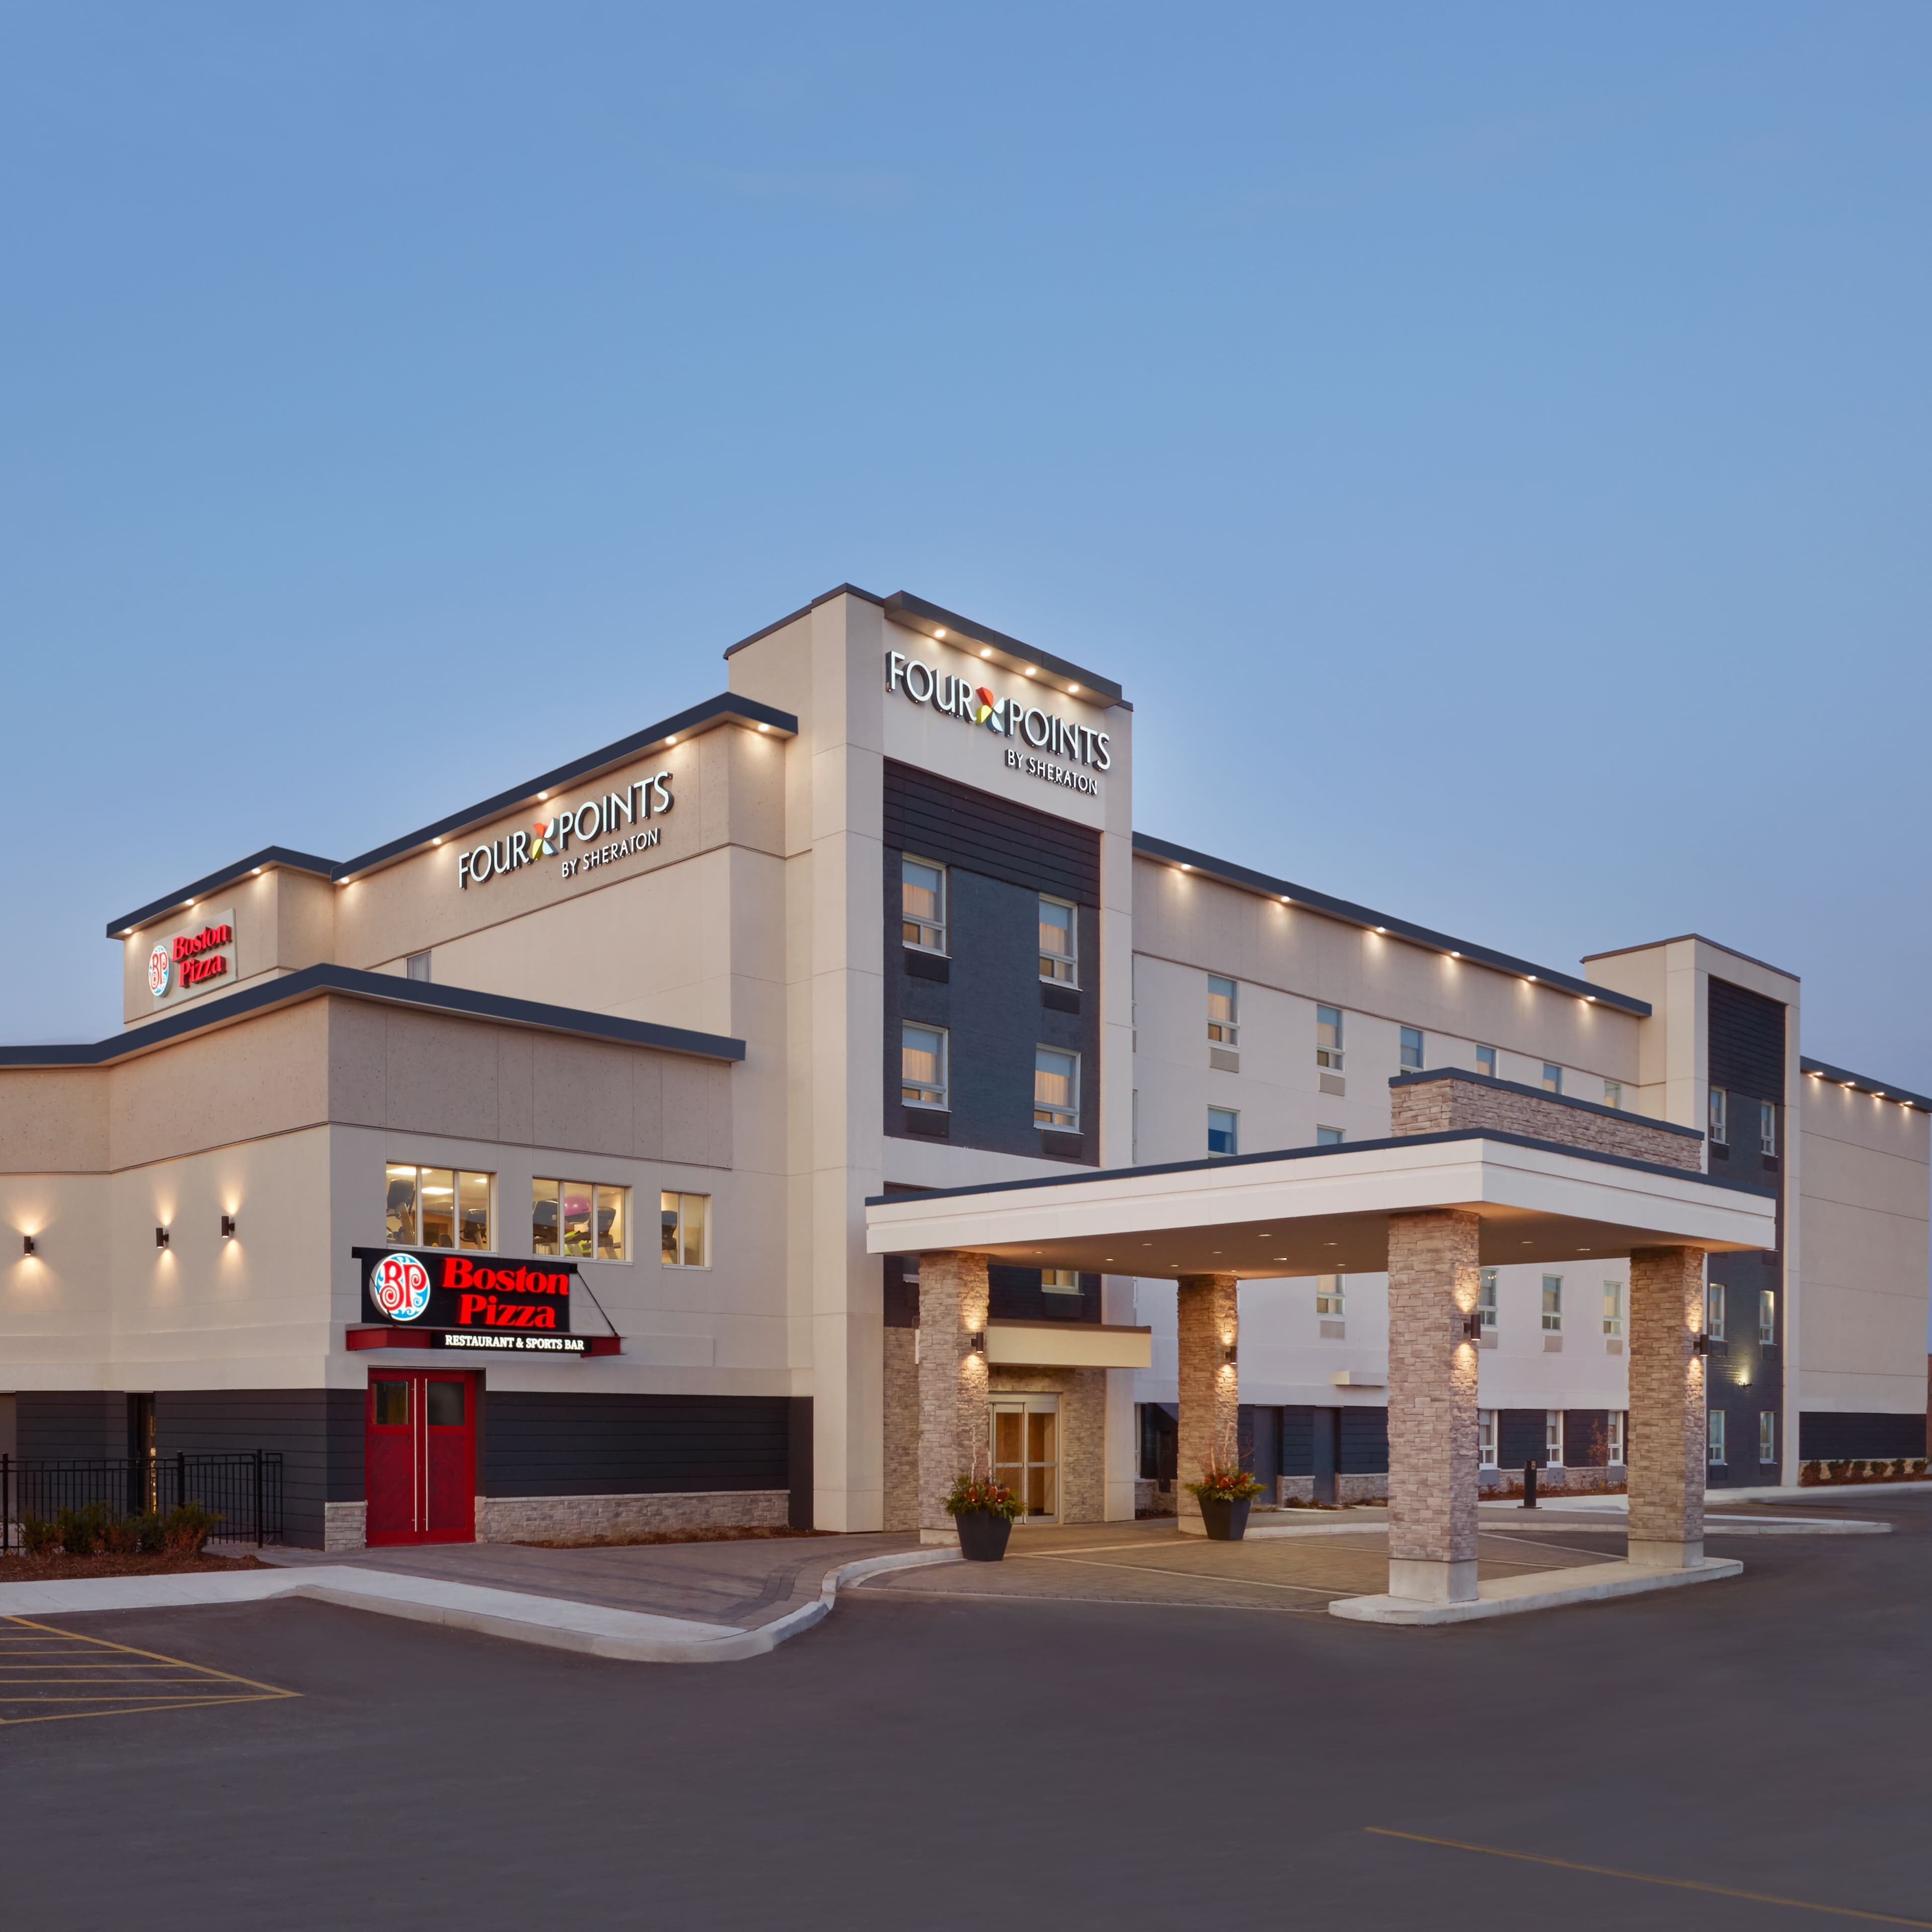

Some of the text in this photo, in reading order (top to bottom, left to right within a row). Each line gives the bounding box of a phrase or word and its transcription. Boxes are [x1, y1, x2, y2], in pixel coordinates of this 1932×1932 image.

[886, 651, 1111, 771] FOUR POINTS
[1005, 749, 1098, 795] BY SHERATON
[458, 771, 674, 890] FOUR POINTS
[561, 827, 661, 878] BY SHERATON
[172, 924, 232, 962] Boston
[179, 954, 227, 988] Pizza
[380, 1261, 427, 1310] BP
[442, 1257, 569, 1296] Boston
[458, 1294, 556, 1328] Pizza
[445, 1335, 585, 1350] RESTAURANT & SPORTS BAR
